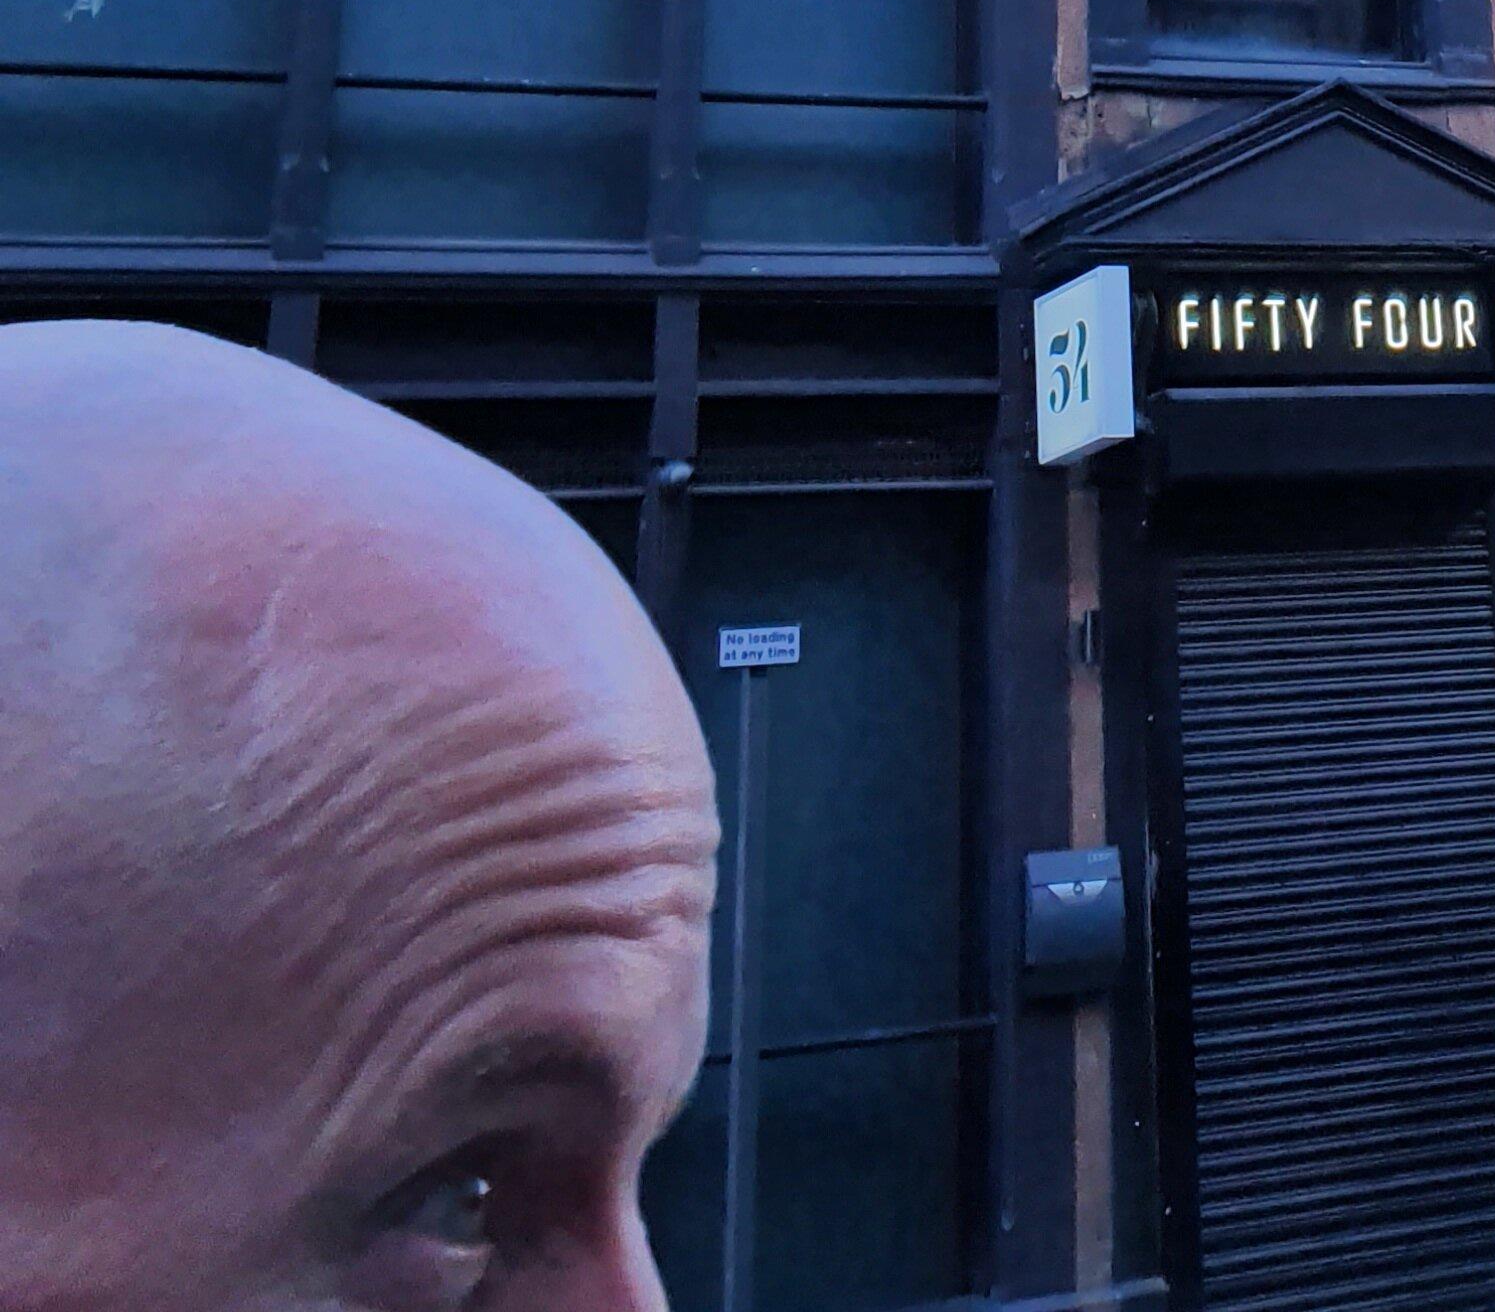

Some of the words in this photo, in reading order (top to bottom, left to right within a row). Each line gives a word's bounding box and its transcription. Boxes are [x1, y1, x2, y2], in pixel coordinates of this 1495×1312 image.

[1178, 297, 1318, 351] FIFTY
[1353, 297, 1477, 349] FOUR
[1049, 319, 1090, 414] 54
[724, 649, 736, 661] at
[741, 650, 763, 661] any
[768, 647, 795, 658] time
[726, 634, 744, 645] No
[748, 632, 795, 644] loading
